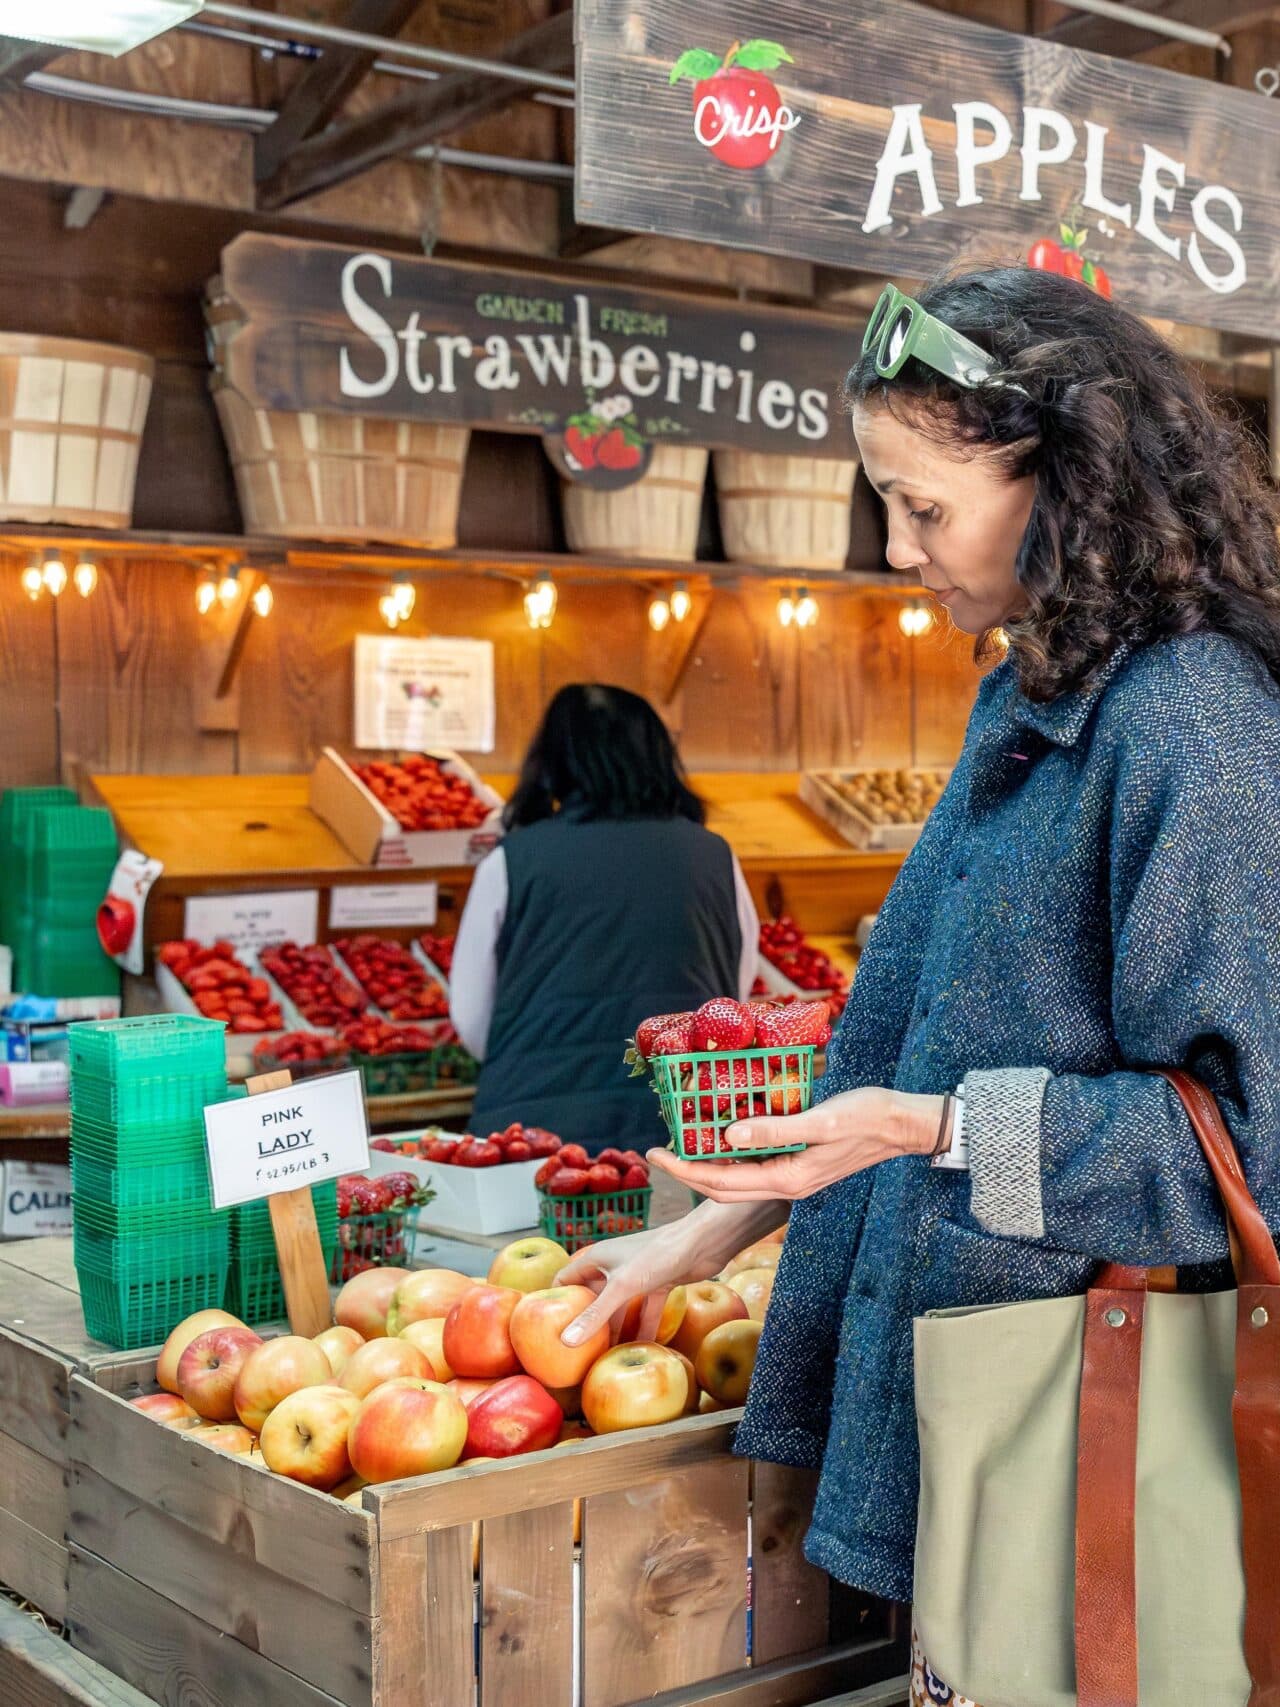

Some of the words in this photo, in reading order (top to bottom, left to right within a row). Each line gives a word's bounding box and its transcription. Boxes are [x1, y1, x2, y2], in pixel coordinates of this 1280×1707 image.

[694, 89, 802, 150] Crisp
[861, 102, 1248, 294] APPLES
[476, 293, 565, 325] GARDEN
[601, 307, 668, 338] FRESH
[339, 253, 830, 440] Strawberries
[258, 1129, 313, 1155] LADY
[262, 1106, 304, 1127] PINK
